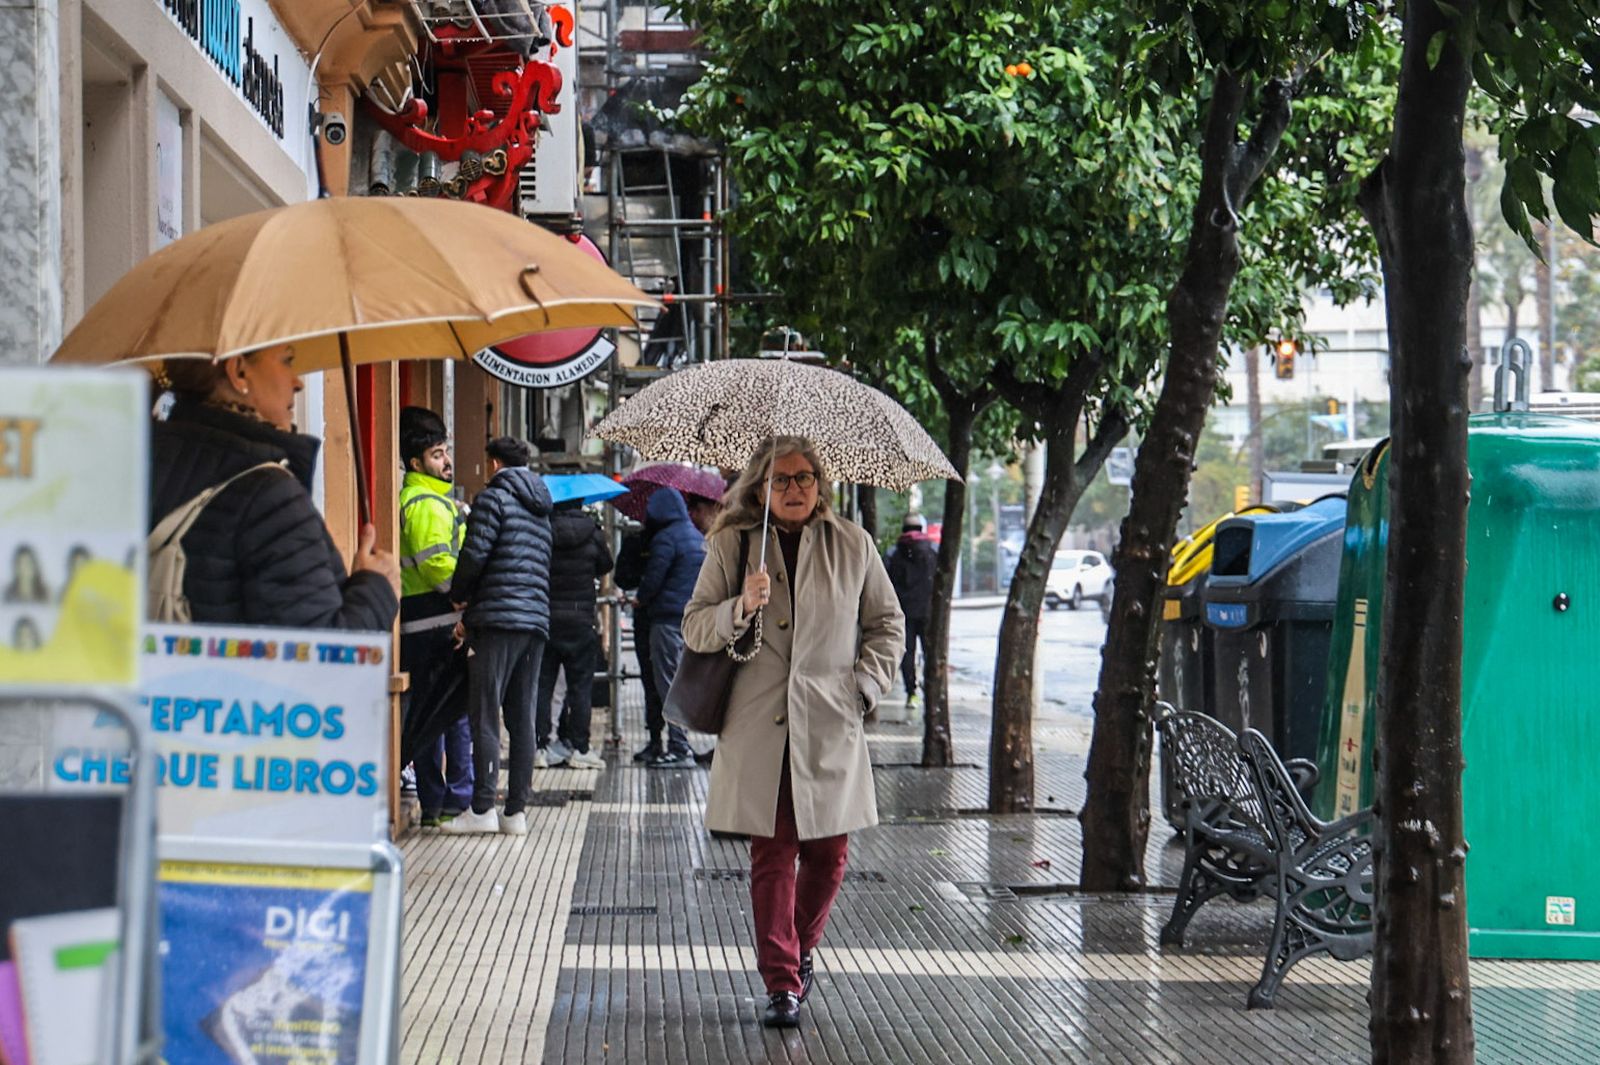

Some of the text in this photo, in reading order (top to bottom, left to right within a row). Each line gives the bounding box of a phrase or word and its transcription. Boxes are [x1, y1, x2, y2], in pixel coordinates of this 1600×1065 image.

[477, 350, 602, 384] ALIMENTACION ALAMEDA
[283, 640, 311, 662] DE
[316, 643, 383, 665] TEXTO
[233, 754, 378, 797] LIBROS
[265, 905, 350, 941] DIGI
